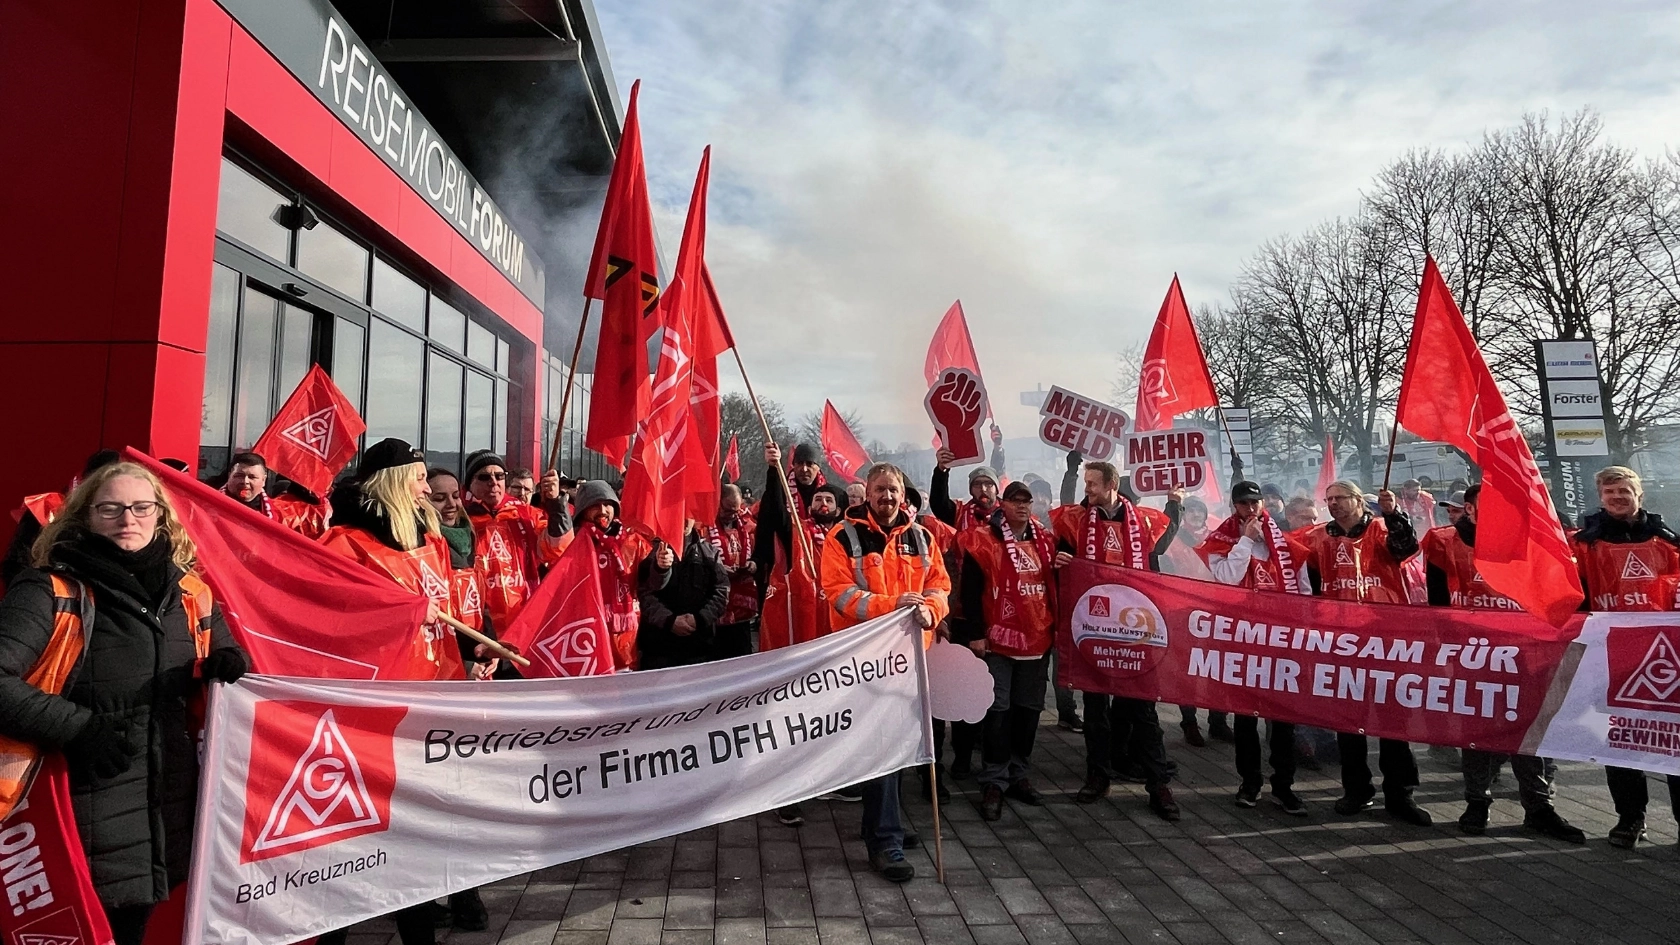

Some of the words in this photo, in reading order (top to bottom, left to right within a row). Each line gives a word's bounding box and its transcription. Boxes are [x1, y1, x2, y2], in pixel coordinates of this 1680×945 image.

[1046, 390, 1126, 439] MEHR
[1554, 393, 1599, 404] Forster
[1043, 417, 1112, 460] GELD
[1129, 431, 1206, 465] MEHR
[1135, 460, 1203, 492] GELD
[1093, 645, 1146, 660] MehrWert
[1096, 657, 1115, 668] mit
[1117, 659, 1142, 671] Tarif
[1187, 609, 1425, 664] GEMEINSAM
[1435, 636, 1521, 674] FÜR
[424, 716, 641, 764] Betriebsrat
[645, 702, 712, 733] und
[715, 649, 909, 714] Vertrauensleute
[1187, 647, 1301, 694] MEHR
[1312, 662, 1520, 722] ENTGELT!
[529, 762, 590, 804] der
[599, 742, 700, 788] Firma
[708, 714, 779, 765] DFH
[787, 706, 854, 746] Haus
[235, 876, 277, 904] Bad
[283, 848, 388, 891] Kreuznach
